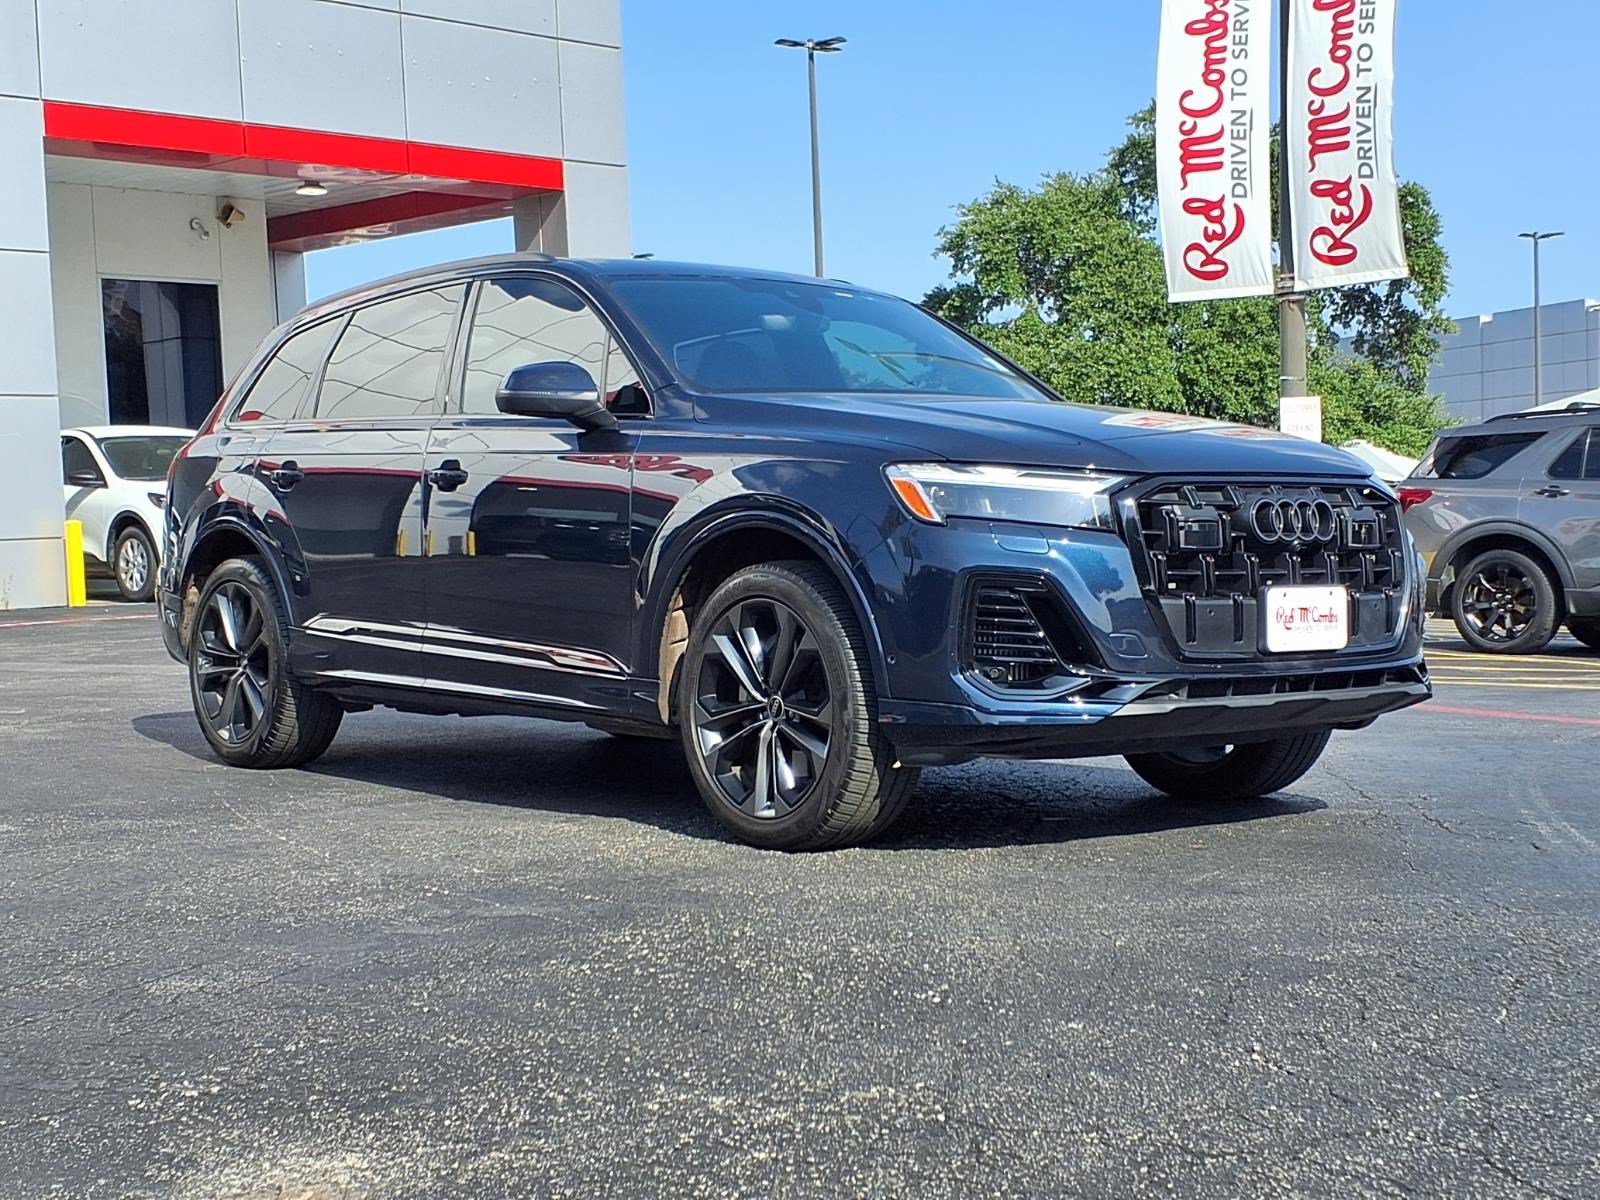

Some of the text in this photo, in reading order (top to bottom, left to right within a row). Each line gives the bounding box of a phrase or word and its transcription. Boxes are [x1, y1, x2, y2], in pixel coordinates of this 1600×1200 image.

[1230, 0, 1250, 198] DRIVEN TO SERV
[1356, 42, 1374, 78] TO
[1356, 85, 1374, 180] DRIVEN
[1183, 194, 1245, 281] Red
[1309, 175, 1373, 266] Red
[1276, 606, 1295, 631] Red
